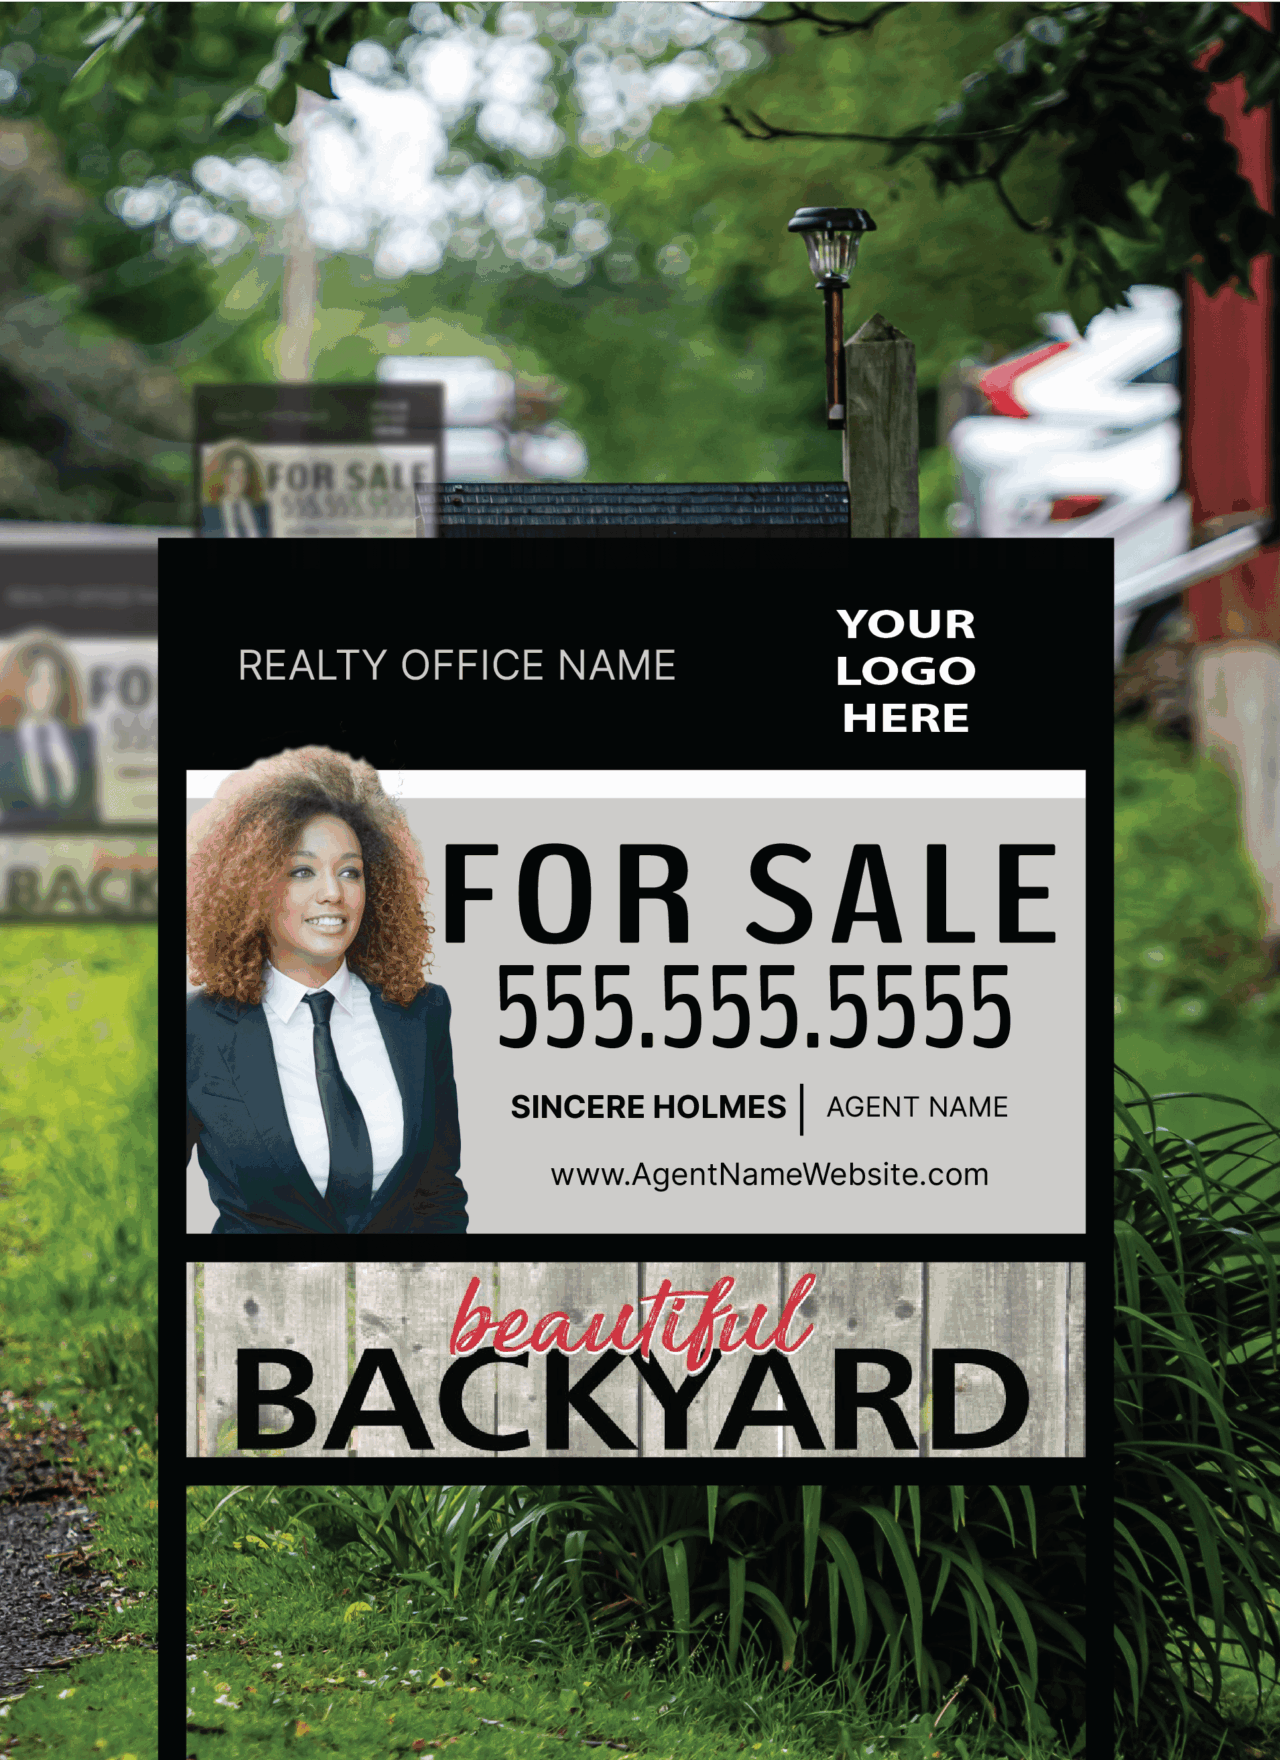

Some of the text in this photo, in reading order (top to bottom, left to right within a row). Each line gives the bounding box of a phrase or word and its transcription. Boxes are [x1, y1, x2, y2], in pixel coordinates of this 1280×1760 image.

[836, 610, 976, 639] YOUR
[240, 649, 676, 680] REALTY OFFICE NAME
[837, 657, 976, 686] LOGO
[843, 704, 969, 733] HERE
[445, 843, 1057, 945] FOR SALE
[499, 964, 1011, 1049] 555.555.5555
[511, 1095, 1008, 1119] SINCERE HOLMES AGENT NAME
[551, 1162, 988, 1193] www.AgentNameWebsite.com
[450, 1272, 817, 1376] beautiful
[236, 1347, 1030, 1451] BACKYARD
